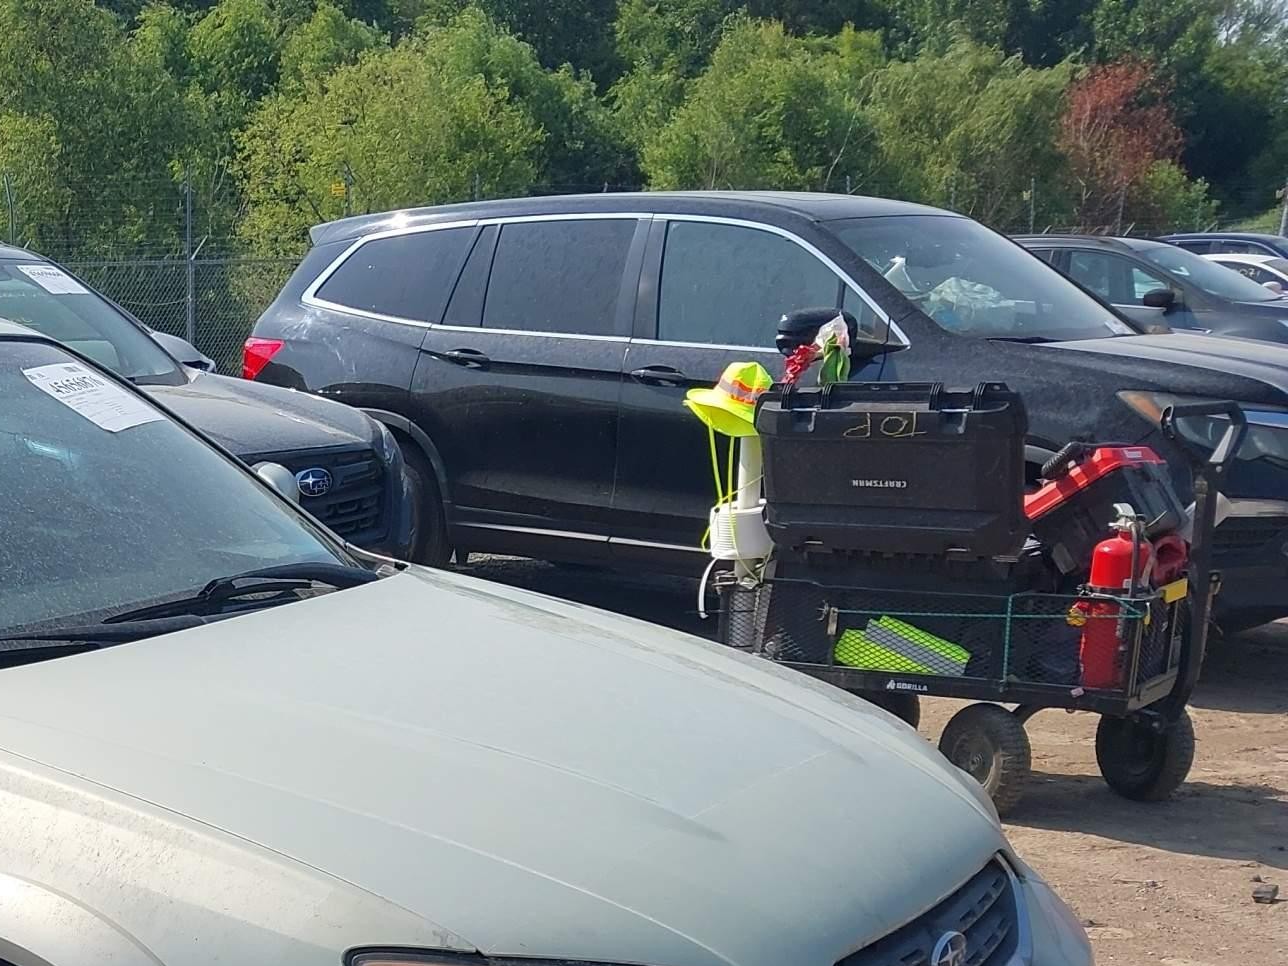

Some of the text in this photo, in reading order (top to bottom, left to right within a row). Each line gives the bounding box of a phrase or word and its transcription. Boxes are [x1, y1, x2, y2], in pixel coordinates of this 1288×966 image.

[48, 375, 105, 395] 45656876
[843, 411, 927, 438] TOP
[852, 480, 907, 488] CRAFTSMAN
[896, 682, 928, 691] GORILLA
